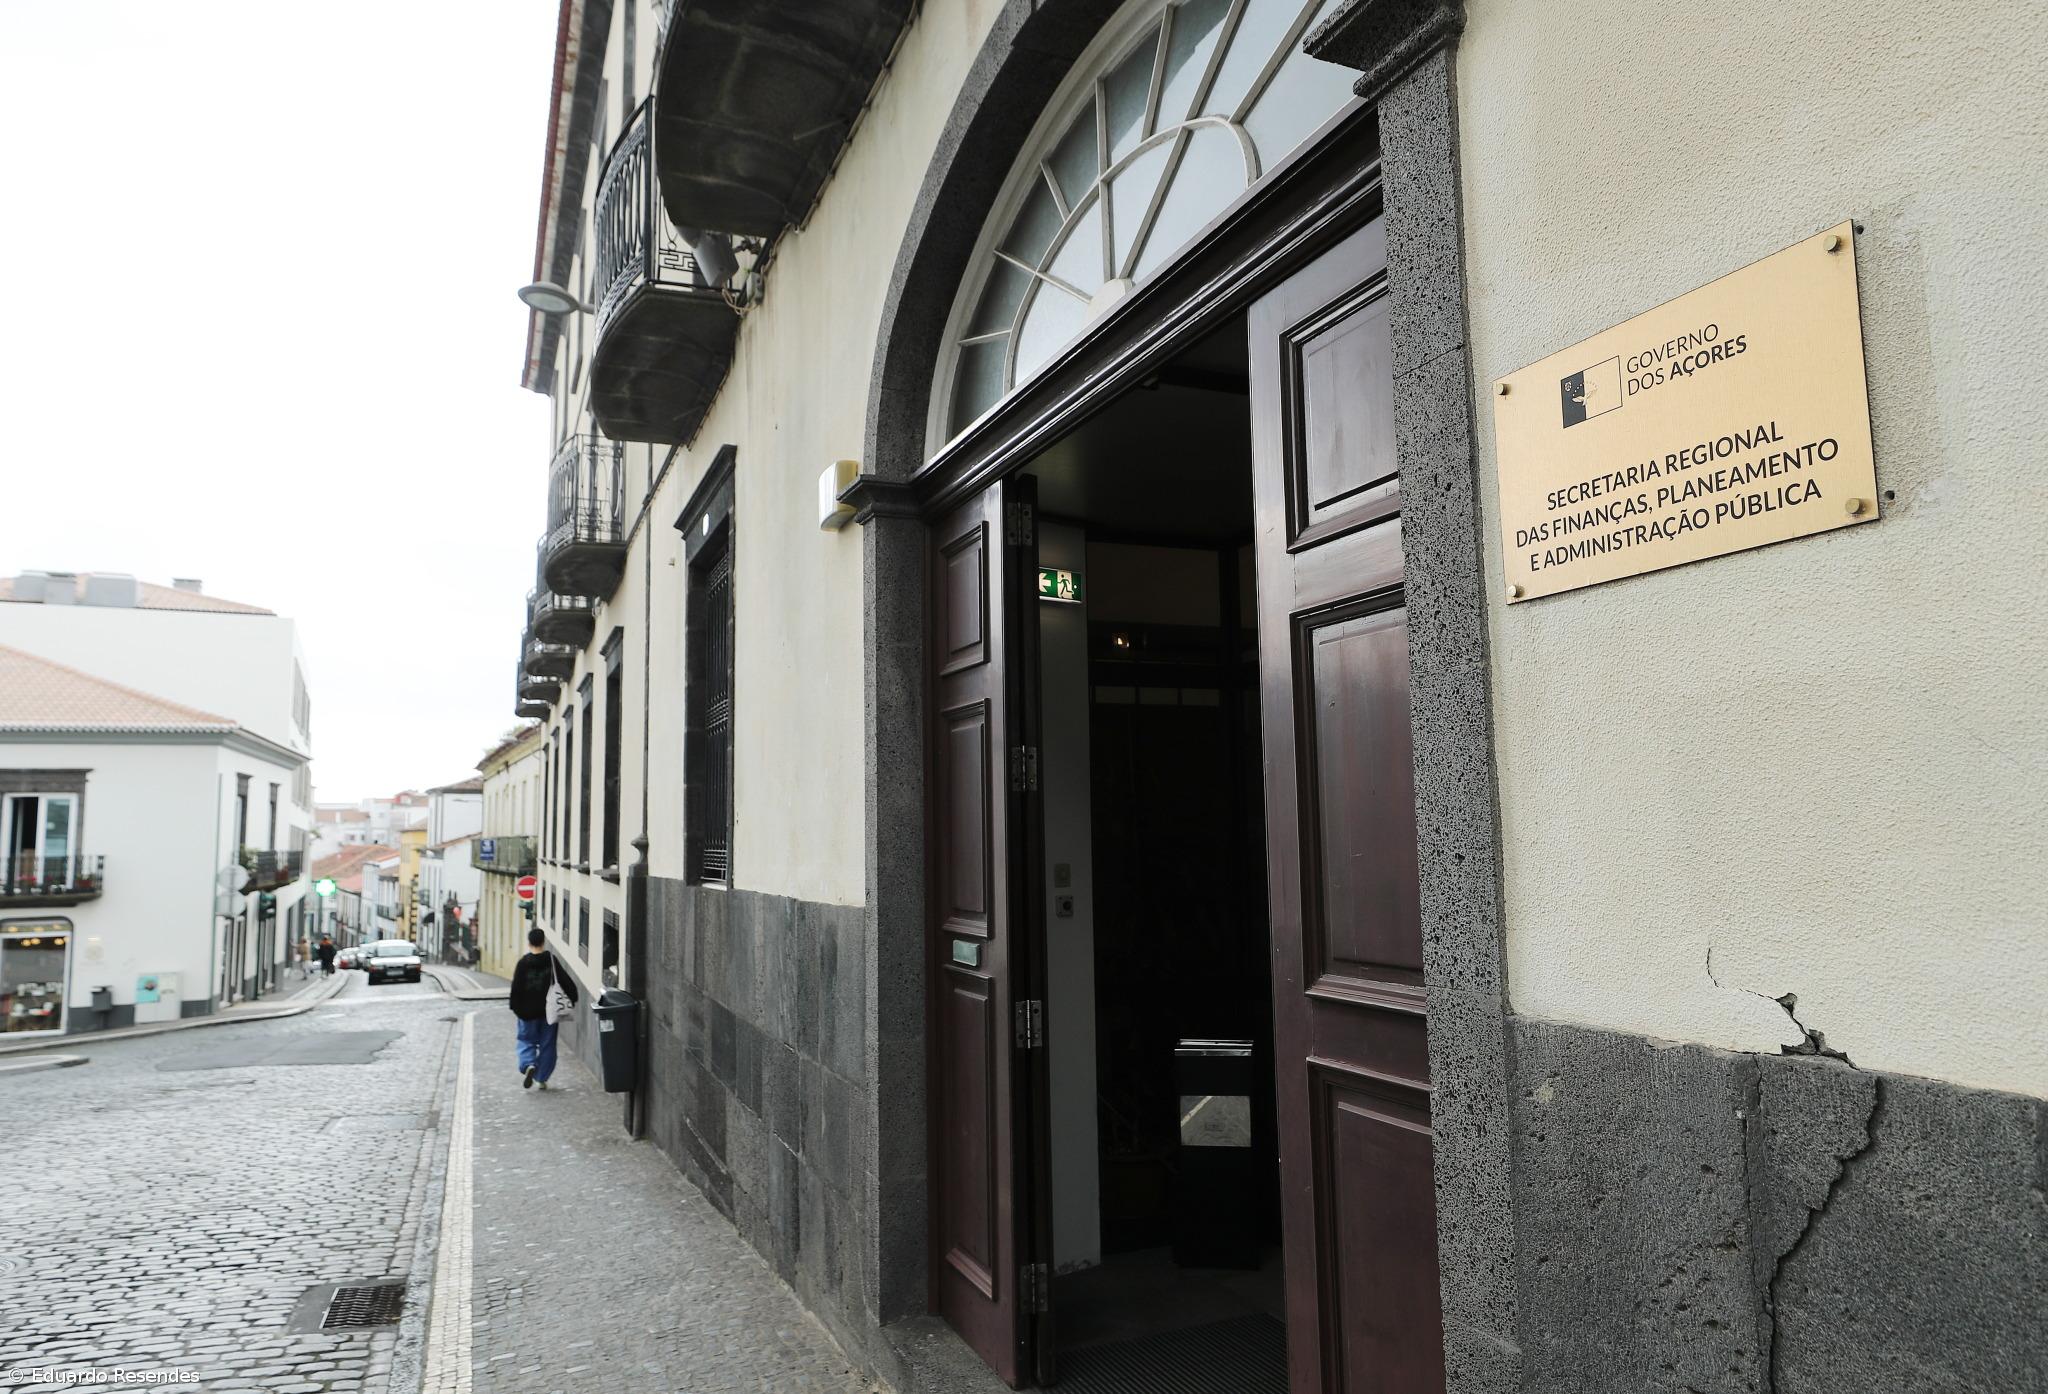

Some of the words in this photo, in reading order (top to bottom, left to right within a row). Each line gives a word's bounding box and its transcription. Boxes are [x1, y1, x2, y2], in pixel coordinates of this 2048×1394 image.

[1627, 323, 1719, 374] GOVERNO
[1627, 368, 1665, 397] DOS
[1669, 334, 1747, 381] AÇORES
[1516, 522, 1549, 548] DAS
[1552, 493, 1653, 537] FINANÇAS,
[1657, 438, 1839, 509] PLANEAMENTO
[1547, 460, 1661, 511] SECRETARIA
[1665, 421, 1784, 474] REGIONAL
[1530, 553, 1540, 572] E
[1543, 508, 1710, 569] ADMINISTRAÇÃO
[1715, 478, 1823, 526] PÚBLICA
